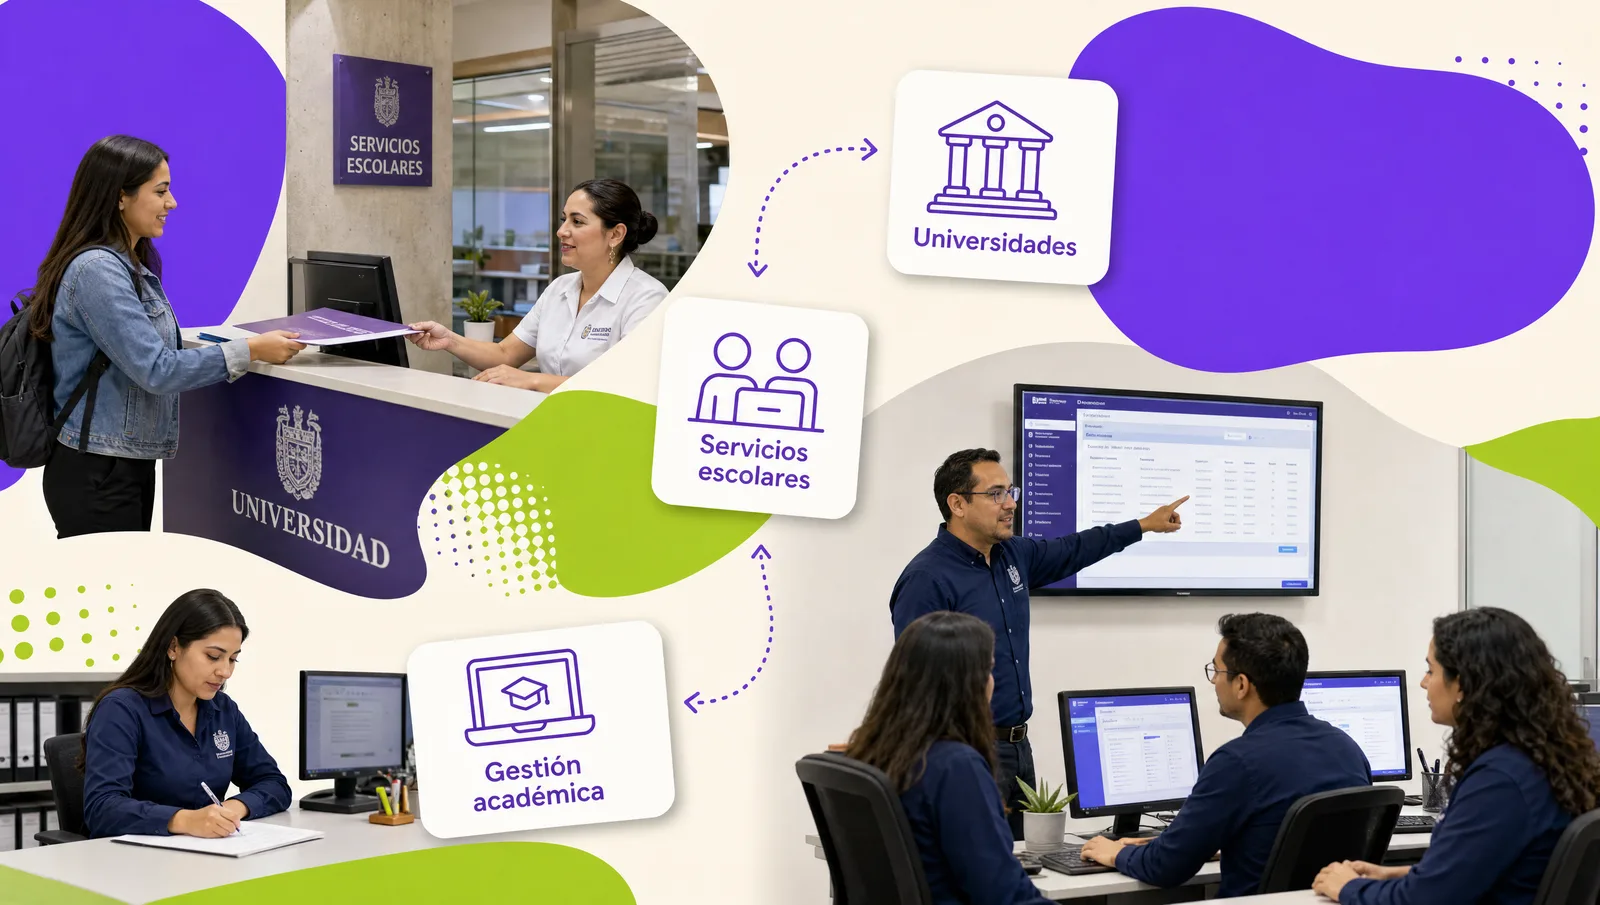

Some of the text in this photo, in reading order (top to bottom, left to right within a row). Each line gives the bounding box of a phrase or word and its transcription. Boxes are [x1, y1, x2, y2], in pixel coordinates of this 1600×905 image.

[350, 135, 420, 155] SERVICIOS
[347, 157, 423, 176] ESCOLARES
[231, 488, 390, 569] UNIVERSIDAD
